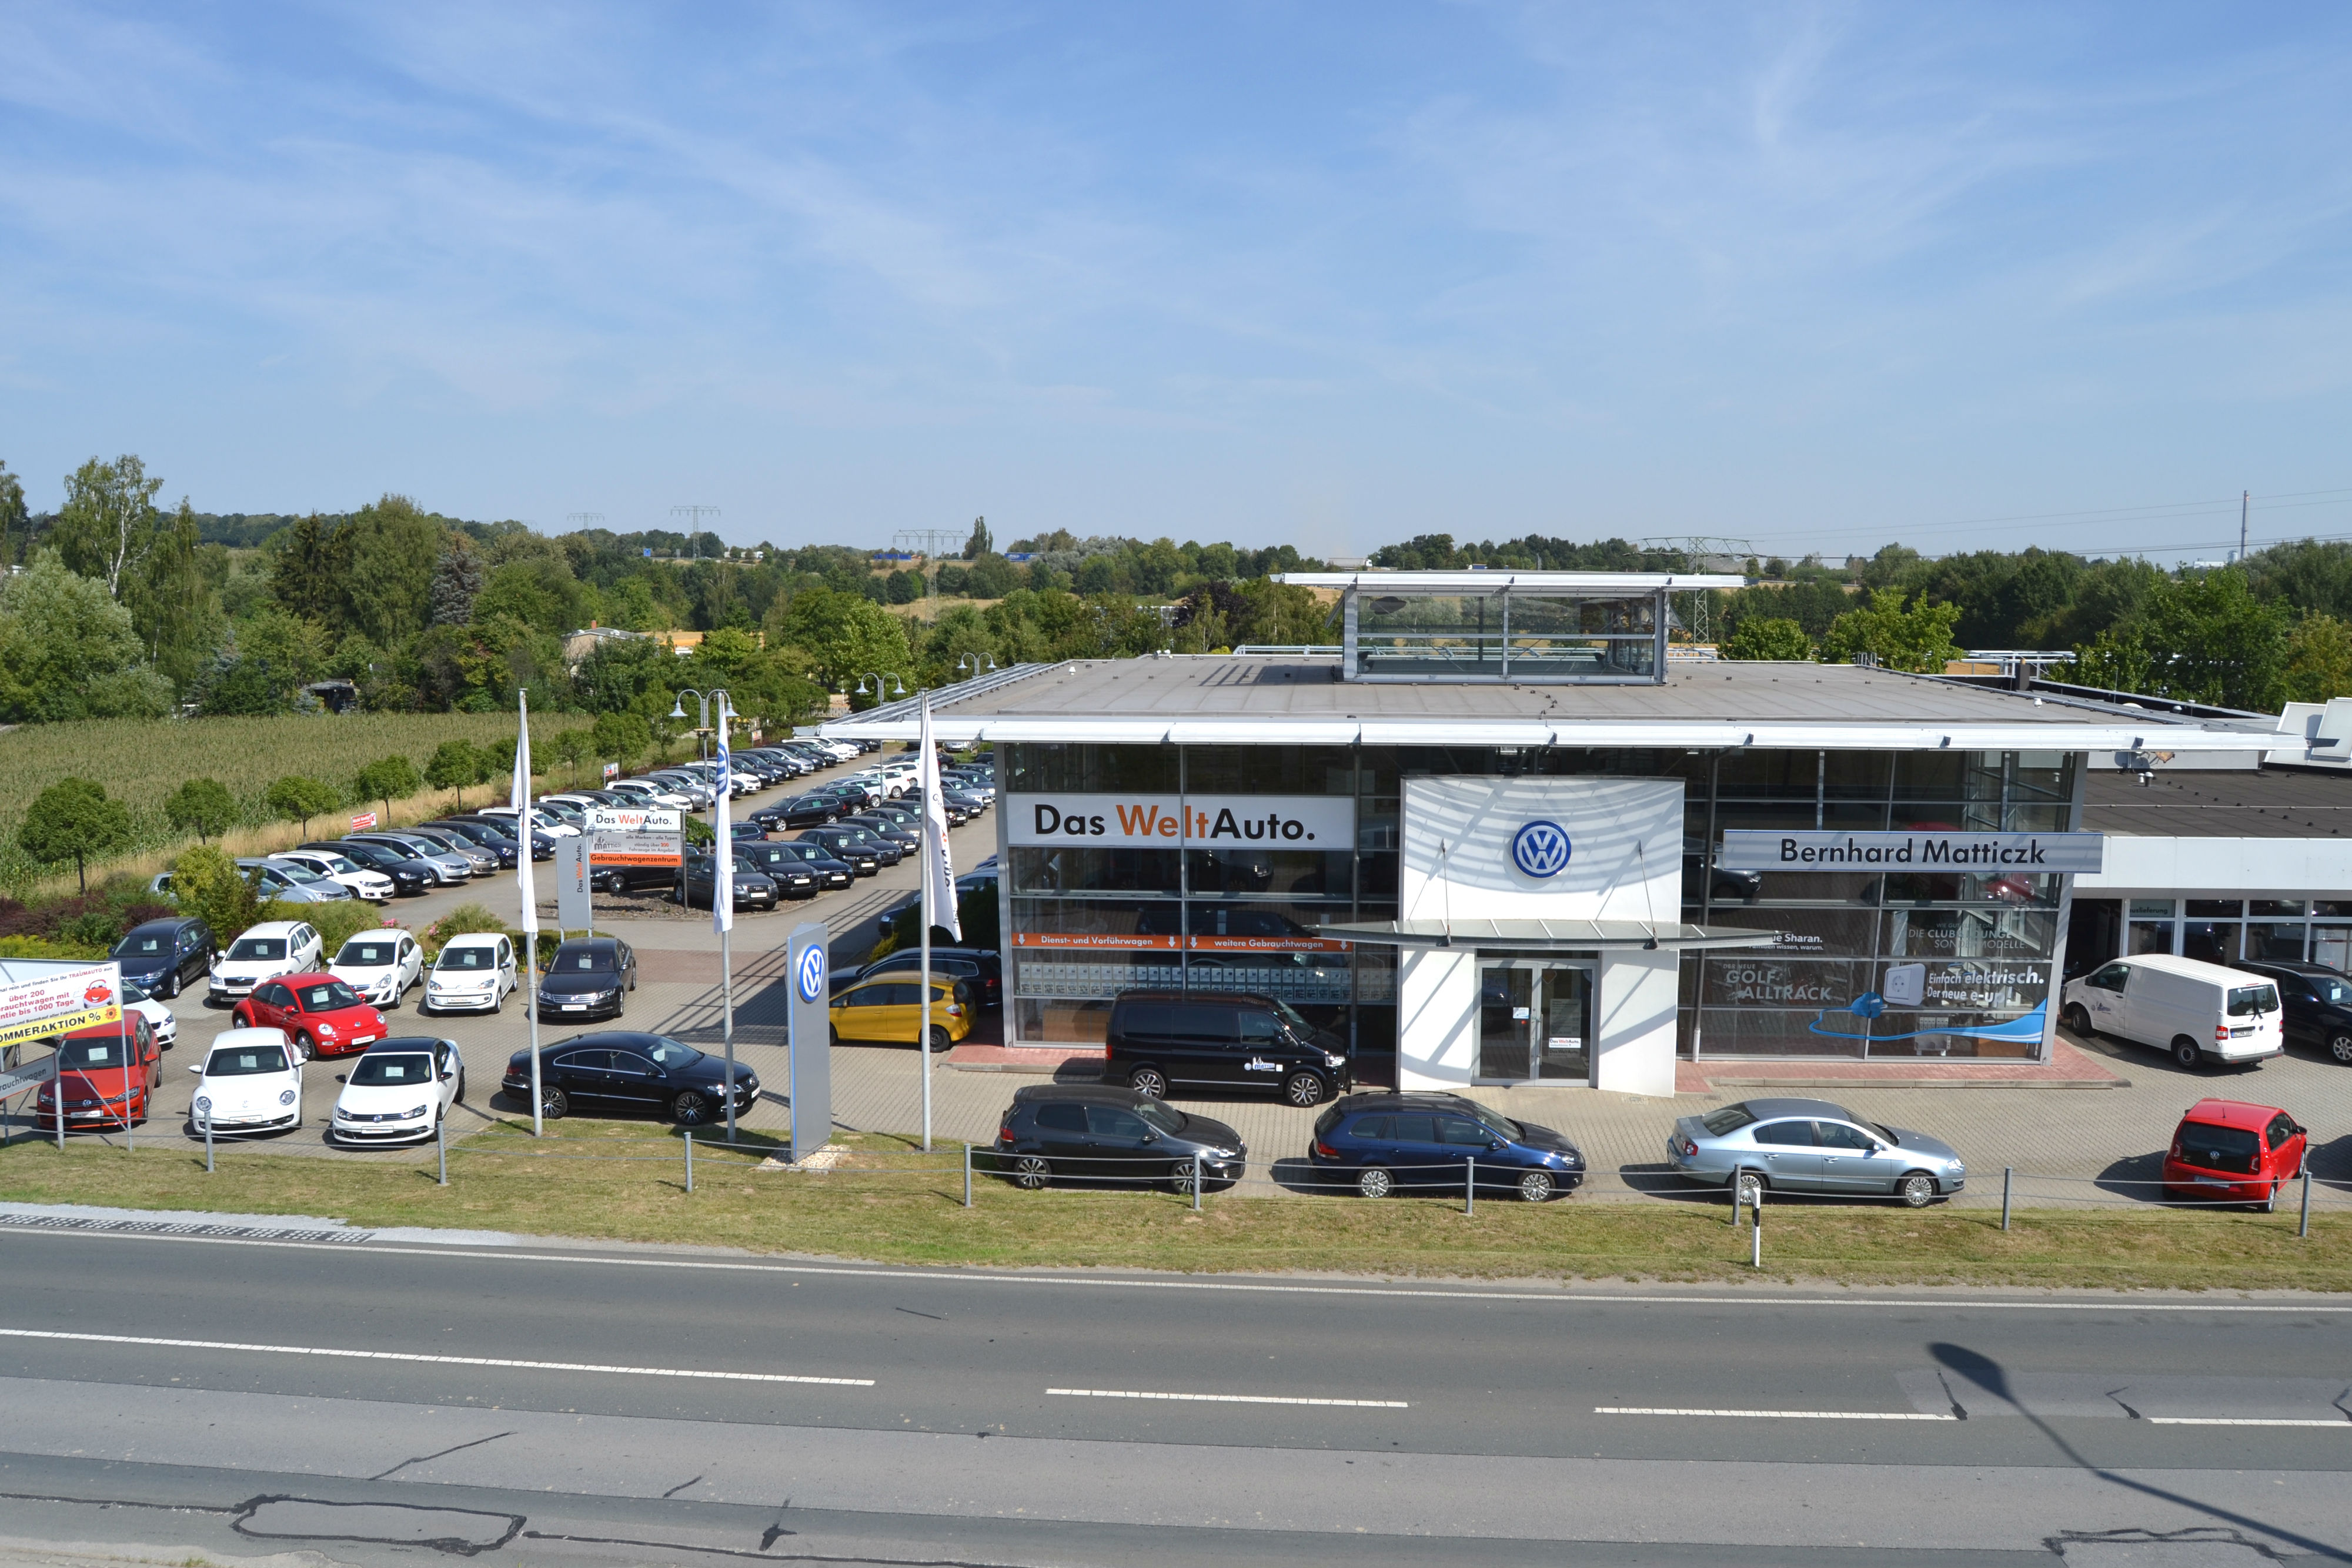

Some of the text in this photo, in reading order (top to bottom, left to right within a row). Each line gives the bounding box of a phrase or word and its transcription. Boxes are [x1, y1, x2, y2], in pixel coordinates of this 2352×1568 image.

[596, 814, 672, 825] Das WeltAuto.
[1035, 804, 1315, 840] Das WeltAuto.
[1780, 838, 2046, 864] Bernhard Matticzk
[590, 854, 678, 863] Gebrauchtwagenzentrum
[1785, 933, 1823, 942] Sharan.
[1908, 929, 1925, 938] DIE
[1091, 937, 1153, 947] Vorführwagen
[1249, 940, 1323, 949] Gebrauchtwagen
[69, 968, 102, 978] TRAUMAUTO
[1726, 969, 1776, 984] GOLF
[1929, 965, 2044, 985] Einfach elektrisch.
[30, 989, 45, 998] 200
[1743, 986, 1832, 1000] ALLTRACK
[1927, 986, 1940, 997] Der
[1942, 989, 1967, 1000] neue
[0, 997, 54, 1011] rauchtwagen
[34, 1002, 53, 1012] 1000
[56, 999, 74, 1008] Tage
[89, 1012, 101, 1022] %
